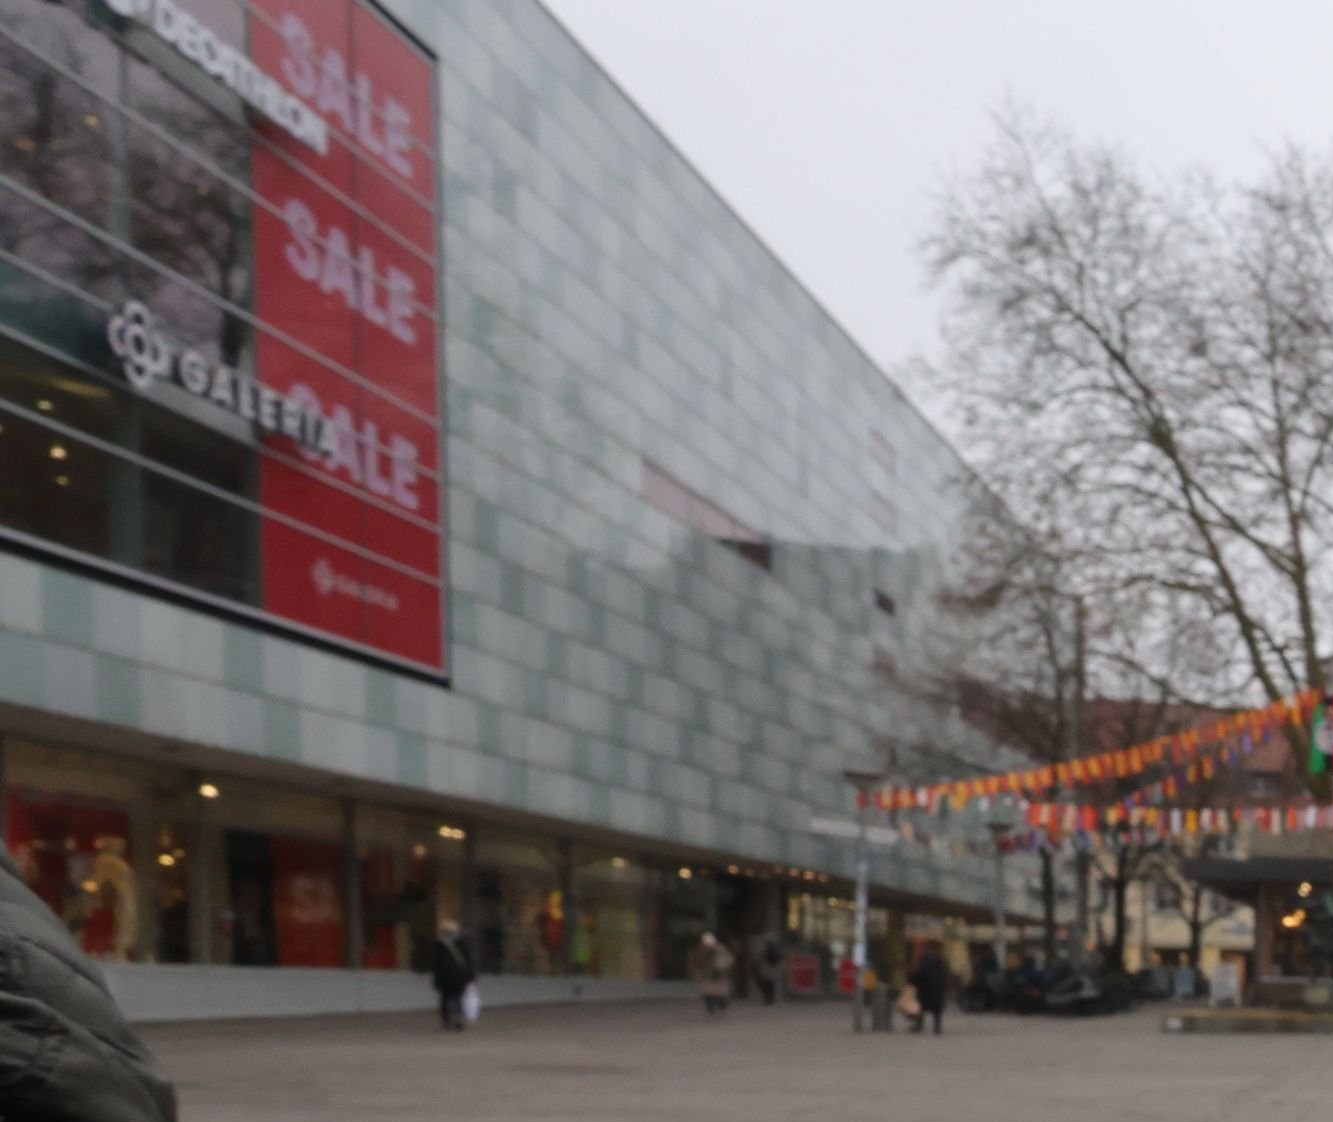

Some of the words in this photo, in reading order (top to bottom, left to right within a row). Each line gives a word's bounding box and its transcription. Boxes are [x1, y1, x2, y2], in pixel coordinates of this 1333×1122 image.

[279, 12, 413, 178] SALE
[284, 198, 417, 344] SALE
[179, 350, 337, 458] GALERIA
